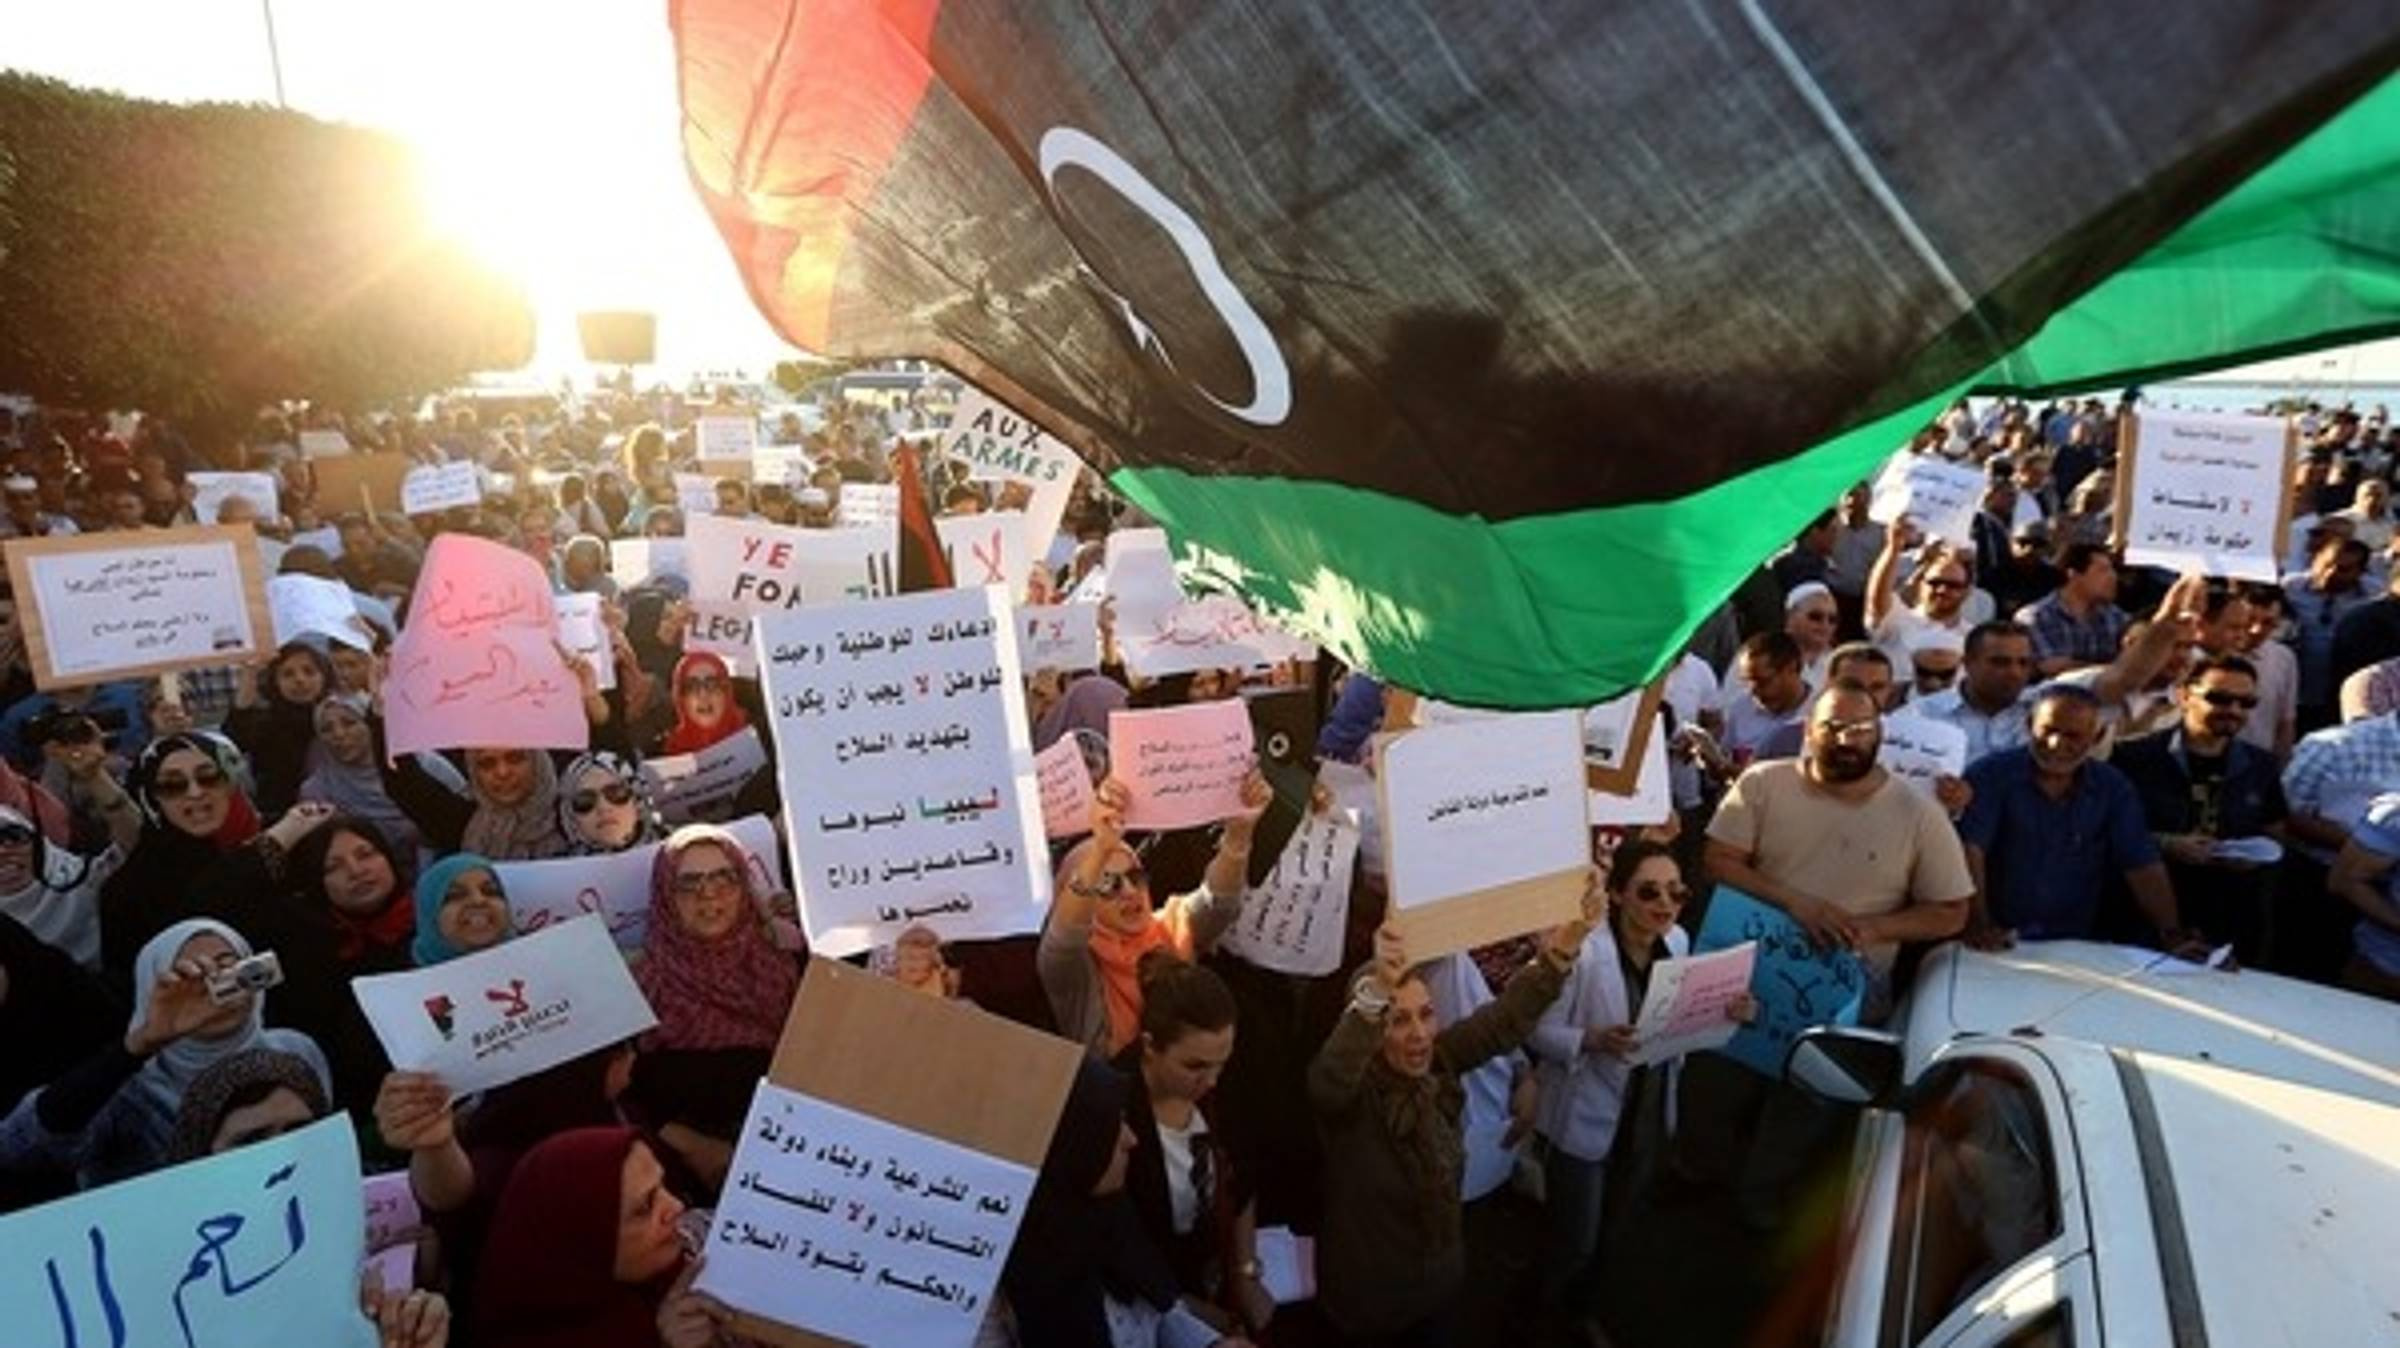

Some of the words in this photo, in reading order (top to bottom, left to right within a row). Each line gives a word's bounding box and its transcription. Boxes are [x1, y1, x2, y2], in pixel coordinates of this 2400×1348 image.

[972, 408, 1041, 450] AUX
[951, 432, 1065, 481] ARMES
[743, 536, 794, 569] YE
[836, 627, 912, 661] للوطنية
[865, 684, 905, 706] يجب
[914, 674, 930, 694] لا
[943, 667, 1003, 699] للوطن
[780, 688, 826, 718] يكون
[836, 732, 895, 763] السلاح
[905, 724, 971, 755] بتهديد
[918, 787, 1000, 825] ليبيا
[827, 865, 871, 890] وراح
[759, 1116, 807, 1154] دولة
[816, 1144, 873, 1179] وبناء
[739, 1171, 839, 1214] للفساد
[884, 1158, 970, 1203] للشرعية
[975, 1195, 1011, 1216] نعم
[720, 1219, 790, 1252] السلاح
[884, 1217, 997, 1260] القانون
[798, 1240, 868, 1281] بقوة
[877, 1267, 978, 1313] والحكم
